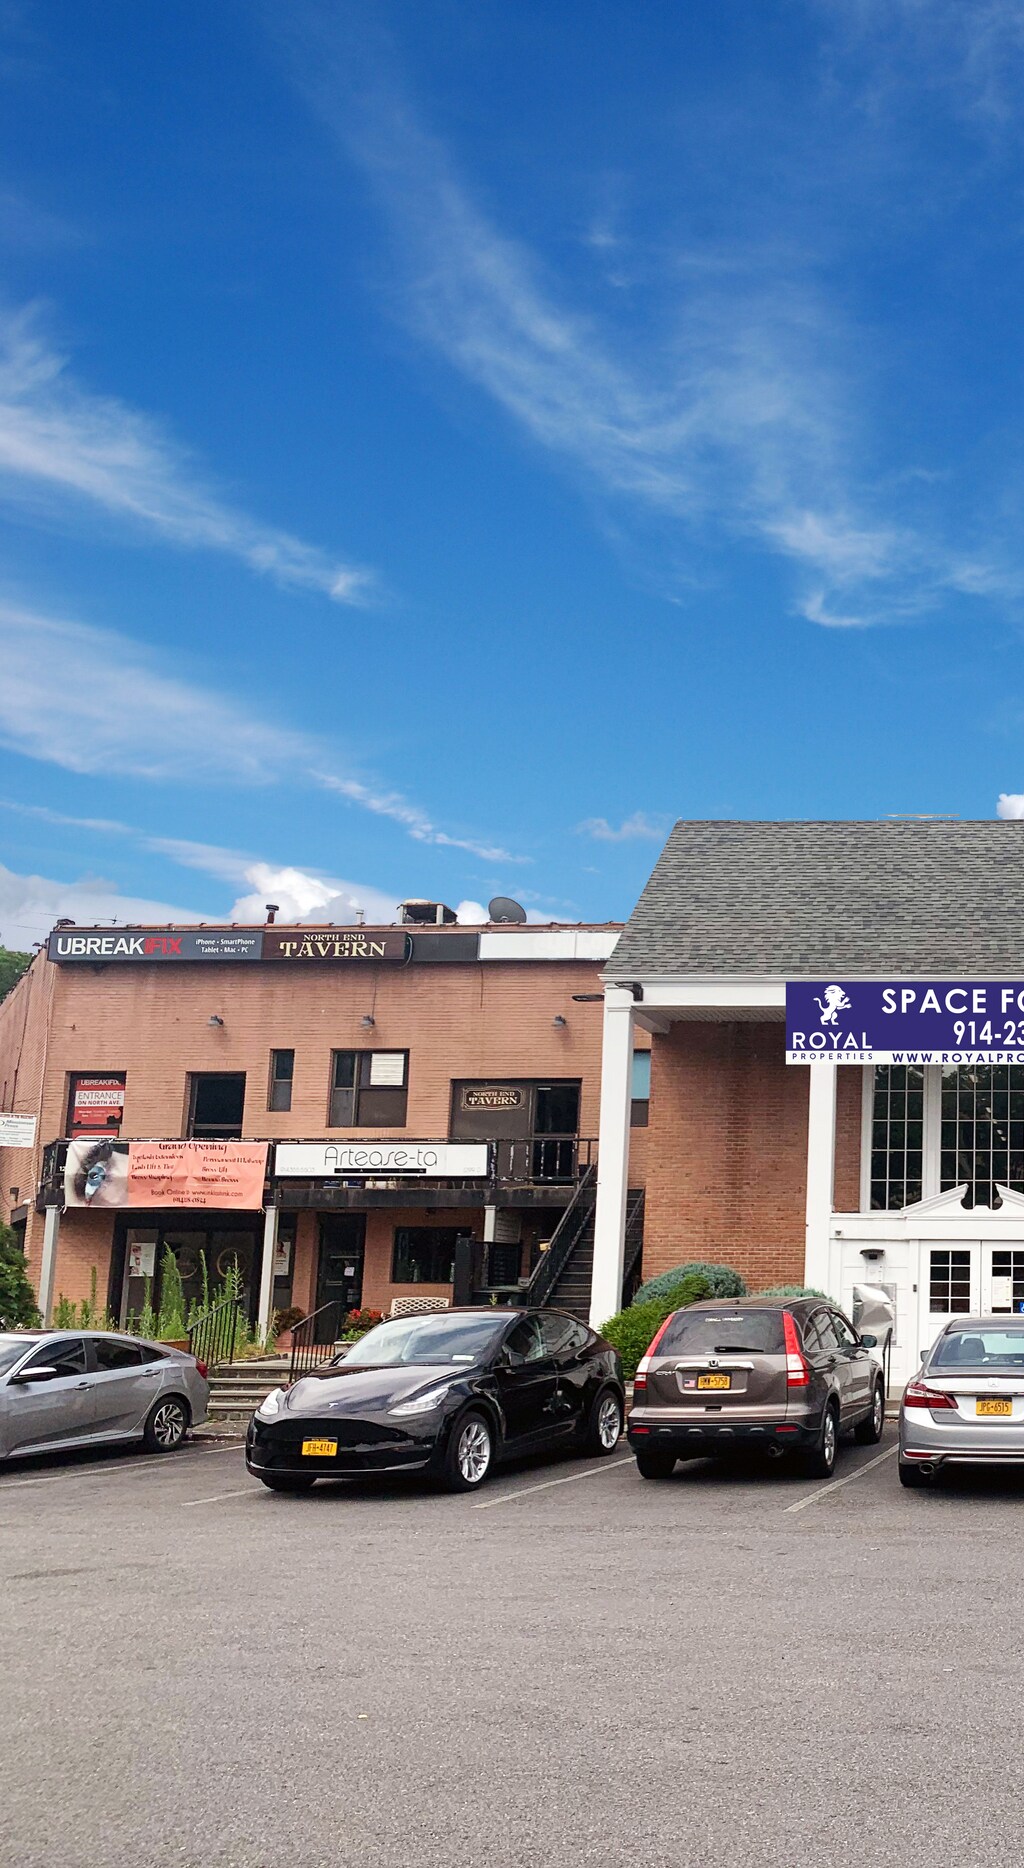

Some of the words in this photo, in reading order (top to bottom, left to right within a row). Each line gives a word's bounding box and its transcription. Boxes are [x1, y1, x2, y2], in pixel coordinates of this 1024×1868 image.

[57, 937, 183, 955] UBREAKIFIX
[280, 941, 387, 957] TAVERN
[881, 988, 987, 1014] SPACE
[792, 1032, 873, 1049] ROYAL
